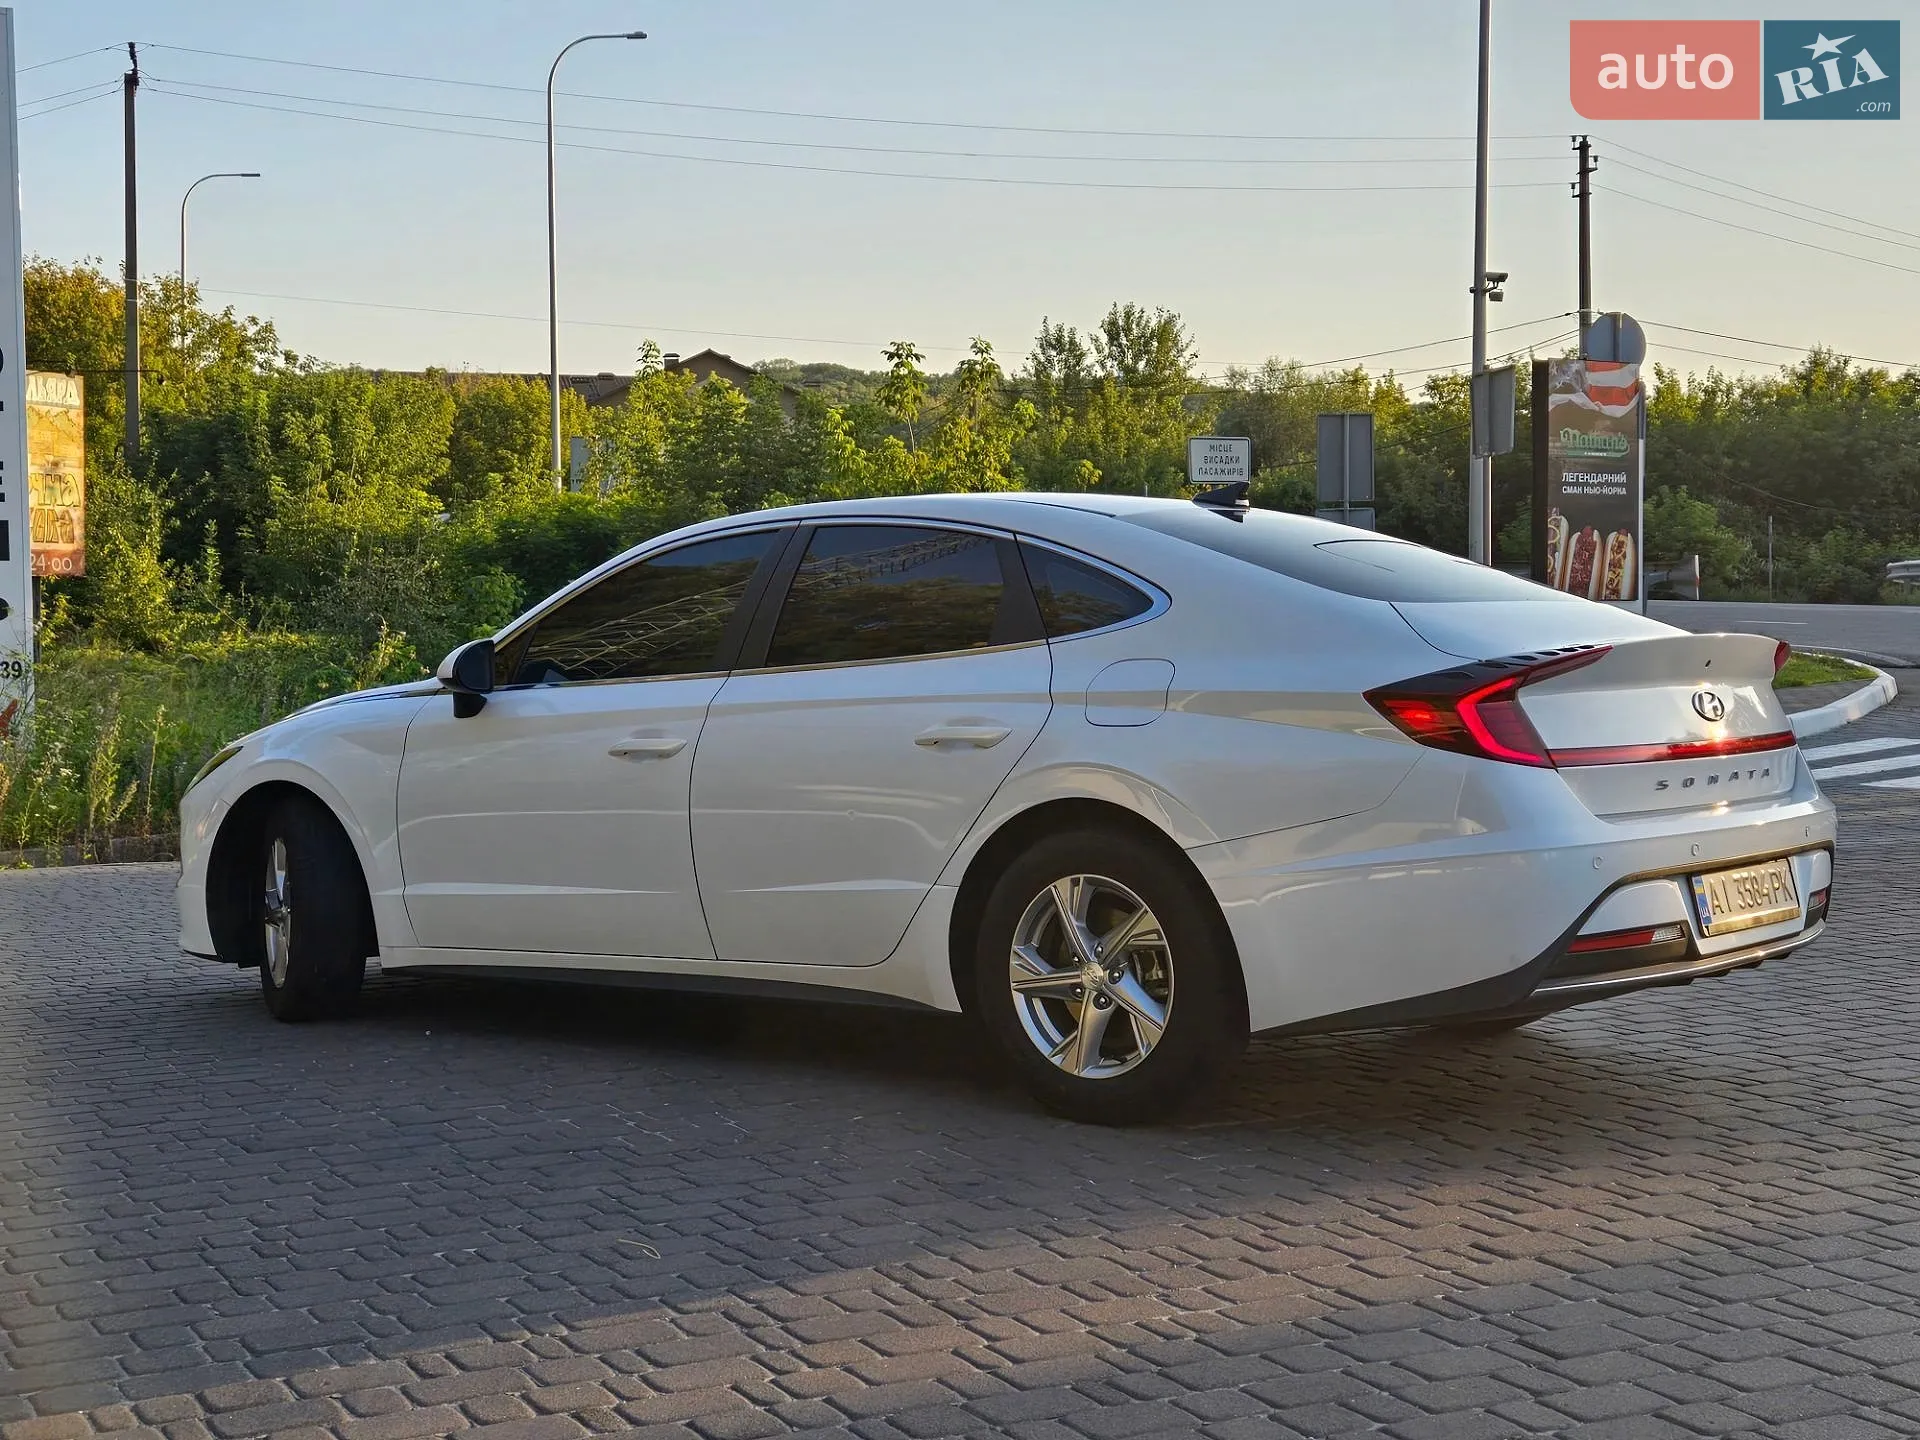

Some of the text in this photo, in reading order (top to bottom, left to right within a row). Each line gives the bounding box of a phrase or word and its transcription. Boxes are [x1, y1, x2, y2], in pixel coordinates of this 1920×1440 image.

[1209, 444, 1233, 453] МІСЦЕ
[1203, 456, 1240, 465] ВИСАДКИ
[1198, 467, 1244, 476] ПАСАЖИРІВ
[1562, 472, 1626, 484] ЛЕГЕНДАРНИЙ
[1562, 485, 1626, 495] СМАК НЬЮ-ЙОРКА
[1655, 768, 1770, 791] SONATA
